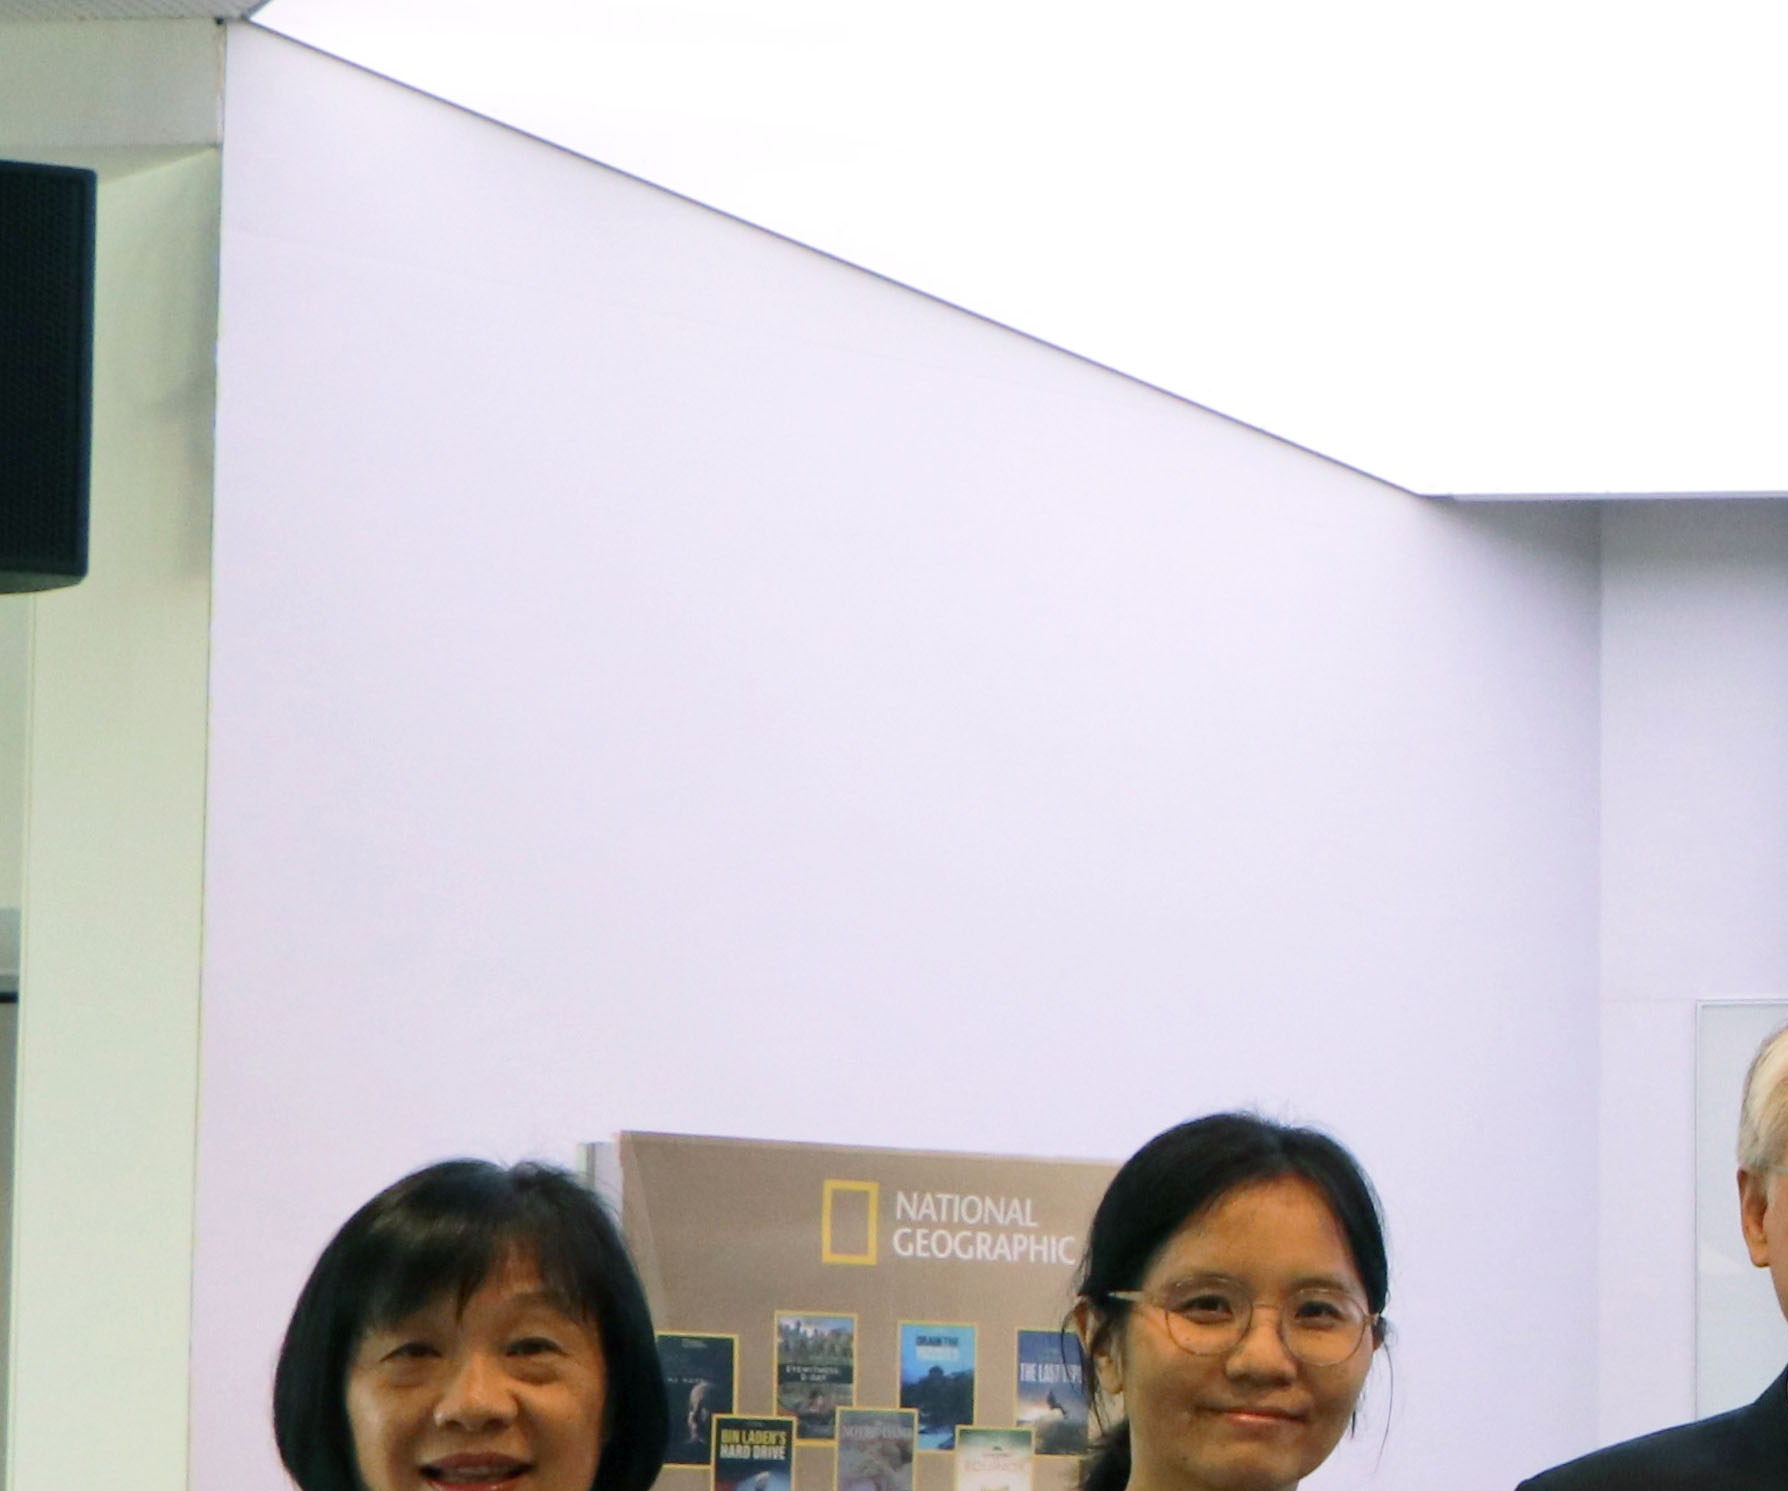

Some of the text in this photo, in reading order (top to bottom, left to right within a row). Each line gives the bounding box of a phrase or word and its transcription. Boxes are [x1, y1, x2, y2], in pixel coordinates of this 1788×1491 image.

[896, 1191, 1039, 1228] NATIONAL
[893, 1228, 1076, 1265] GEOGRAPHIC
[742, 1430, 787, 1445] LADEN'S
[720, 1445, 786, 1460] HARD DRIVE
